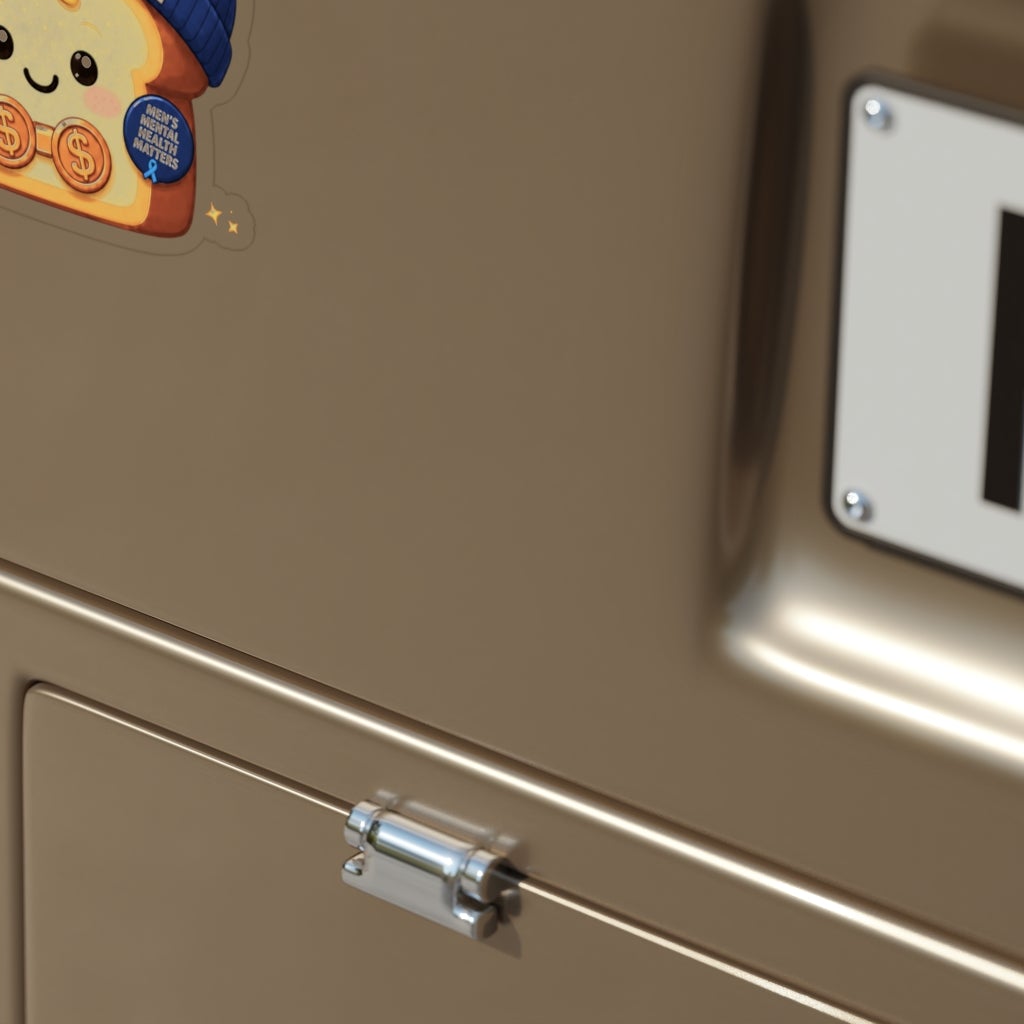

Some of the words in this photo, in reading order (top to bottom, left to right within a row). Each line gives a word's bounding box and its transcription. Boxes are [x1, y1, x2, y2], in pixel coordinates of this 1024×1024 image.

[139, 113, 180, 145] MENTAL
[145, 103, 179, 129] MEN'S
[132, 136, 180, 170] MATTERS
[137, 126, 178, 157] HEALTH
